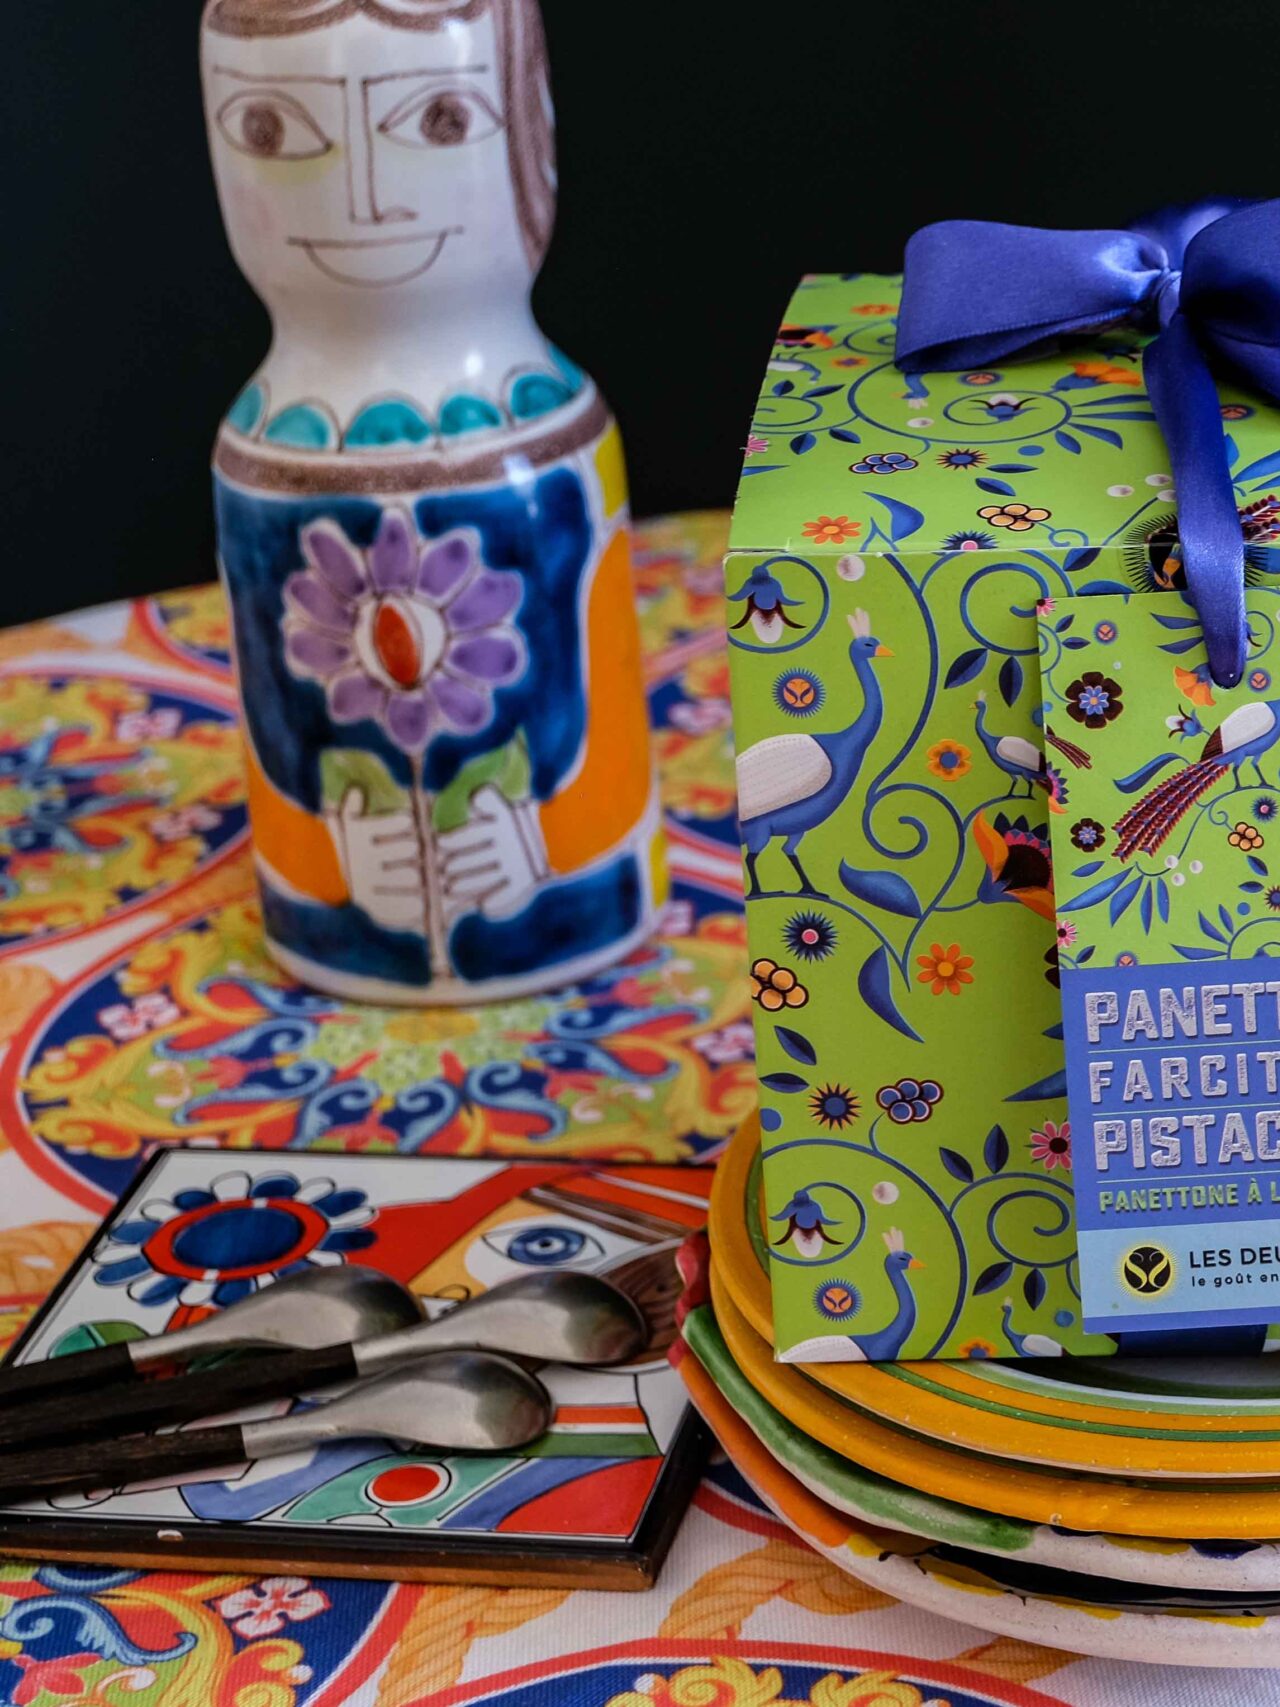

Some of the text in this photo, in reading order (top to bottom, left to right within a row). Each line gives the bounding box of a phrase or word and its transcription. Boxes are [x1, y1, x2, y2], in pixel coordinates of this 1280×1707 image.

[1100, 1184, 1238, 1212] PANETTONE
[1247, 1178, 1262, 1203] À
[1189, 1250, 1231, 1268] LES
[1192, 1275, 1205, 1287] le
[1214, 1272, 1253, 1288] goût
[1260, 1273, 1278, 1283] en
